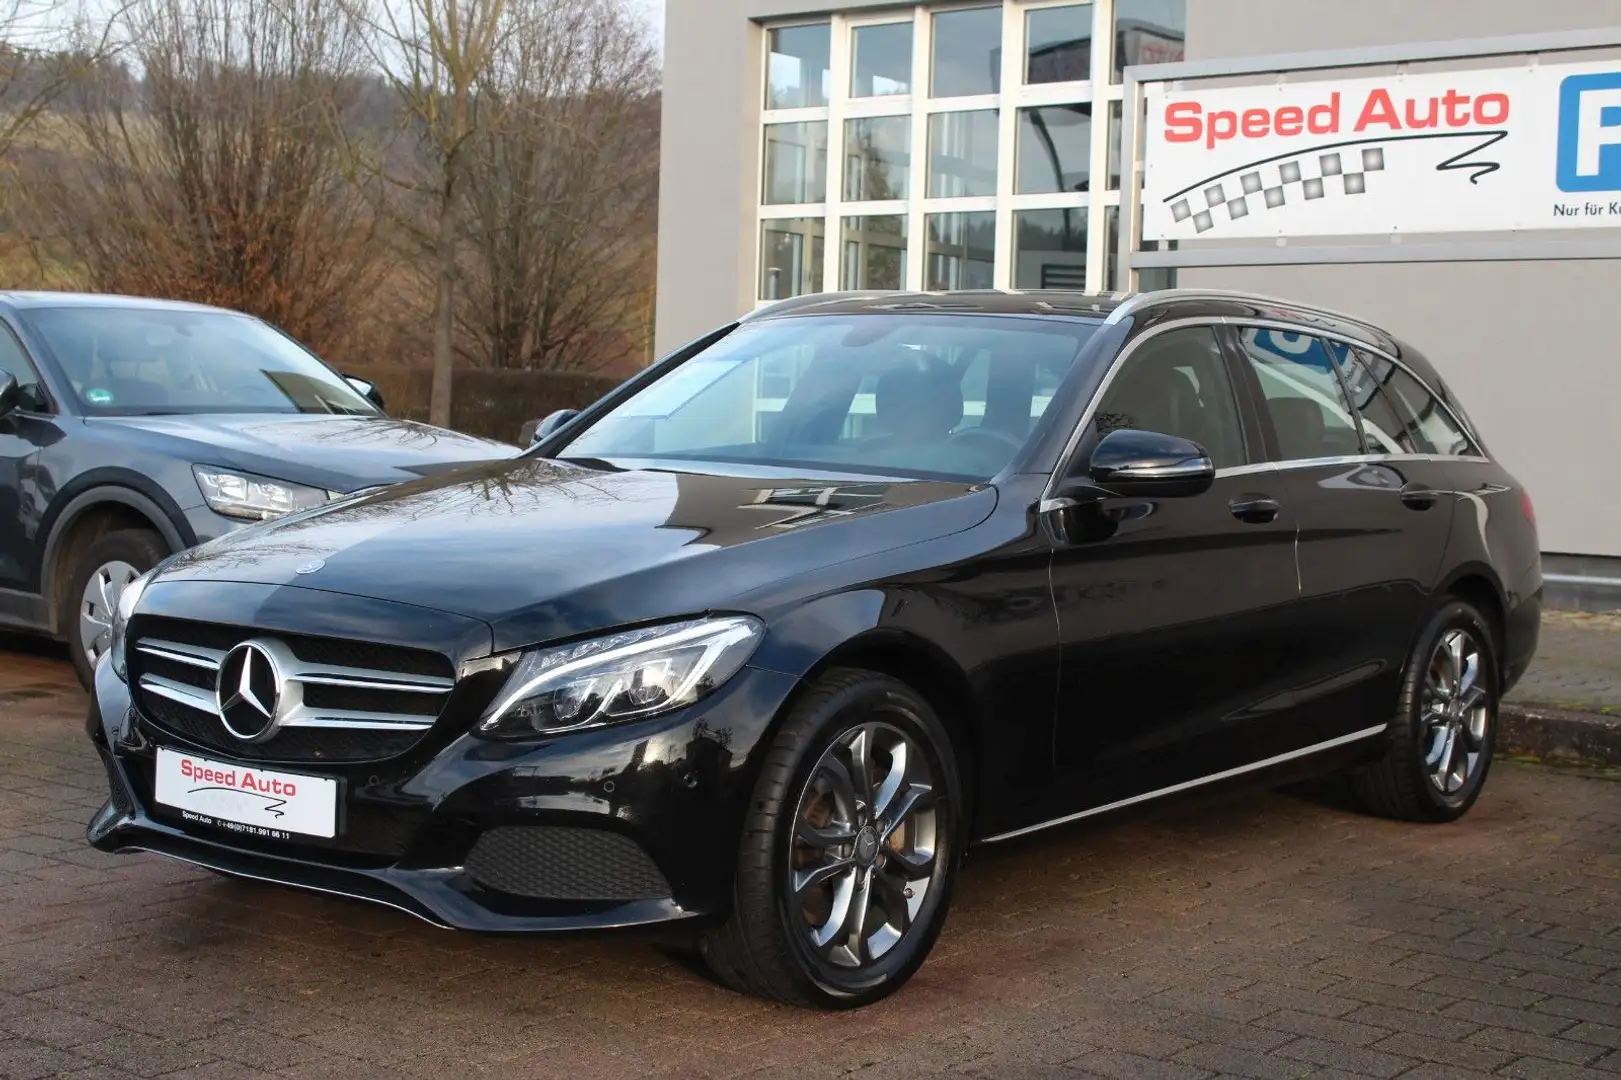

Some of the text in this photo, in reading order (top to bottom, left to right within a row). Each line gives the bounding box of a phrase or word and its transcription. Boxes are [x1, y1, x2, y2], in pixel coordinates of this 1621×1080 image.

[1164, 87, 1511, 151] Speed Auto
[1553, 201, 1621, 217] Nur für K
[180, 758, 297, 797] Speed Auto
[182, 810, 199, 821] Speed
[200, 815, 212, 825] Auto
[271, 830, 281, 839] 66
[282, 832, 291, 840] 11
